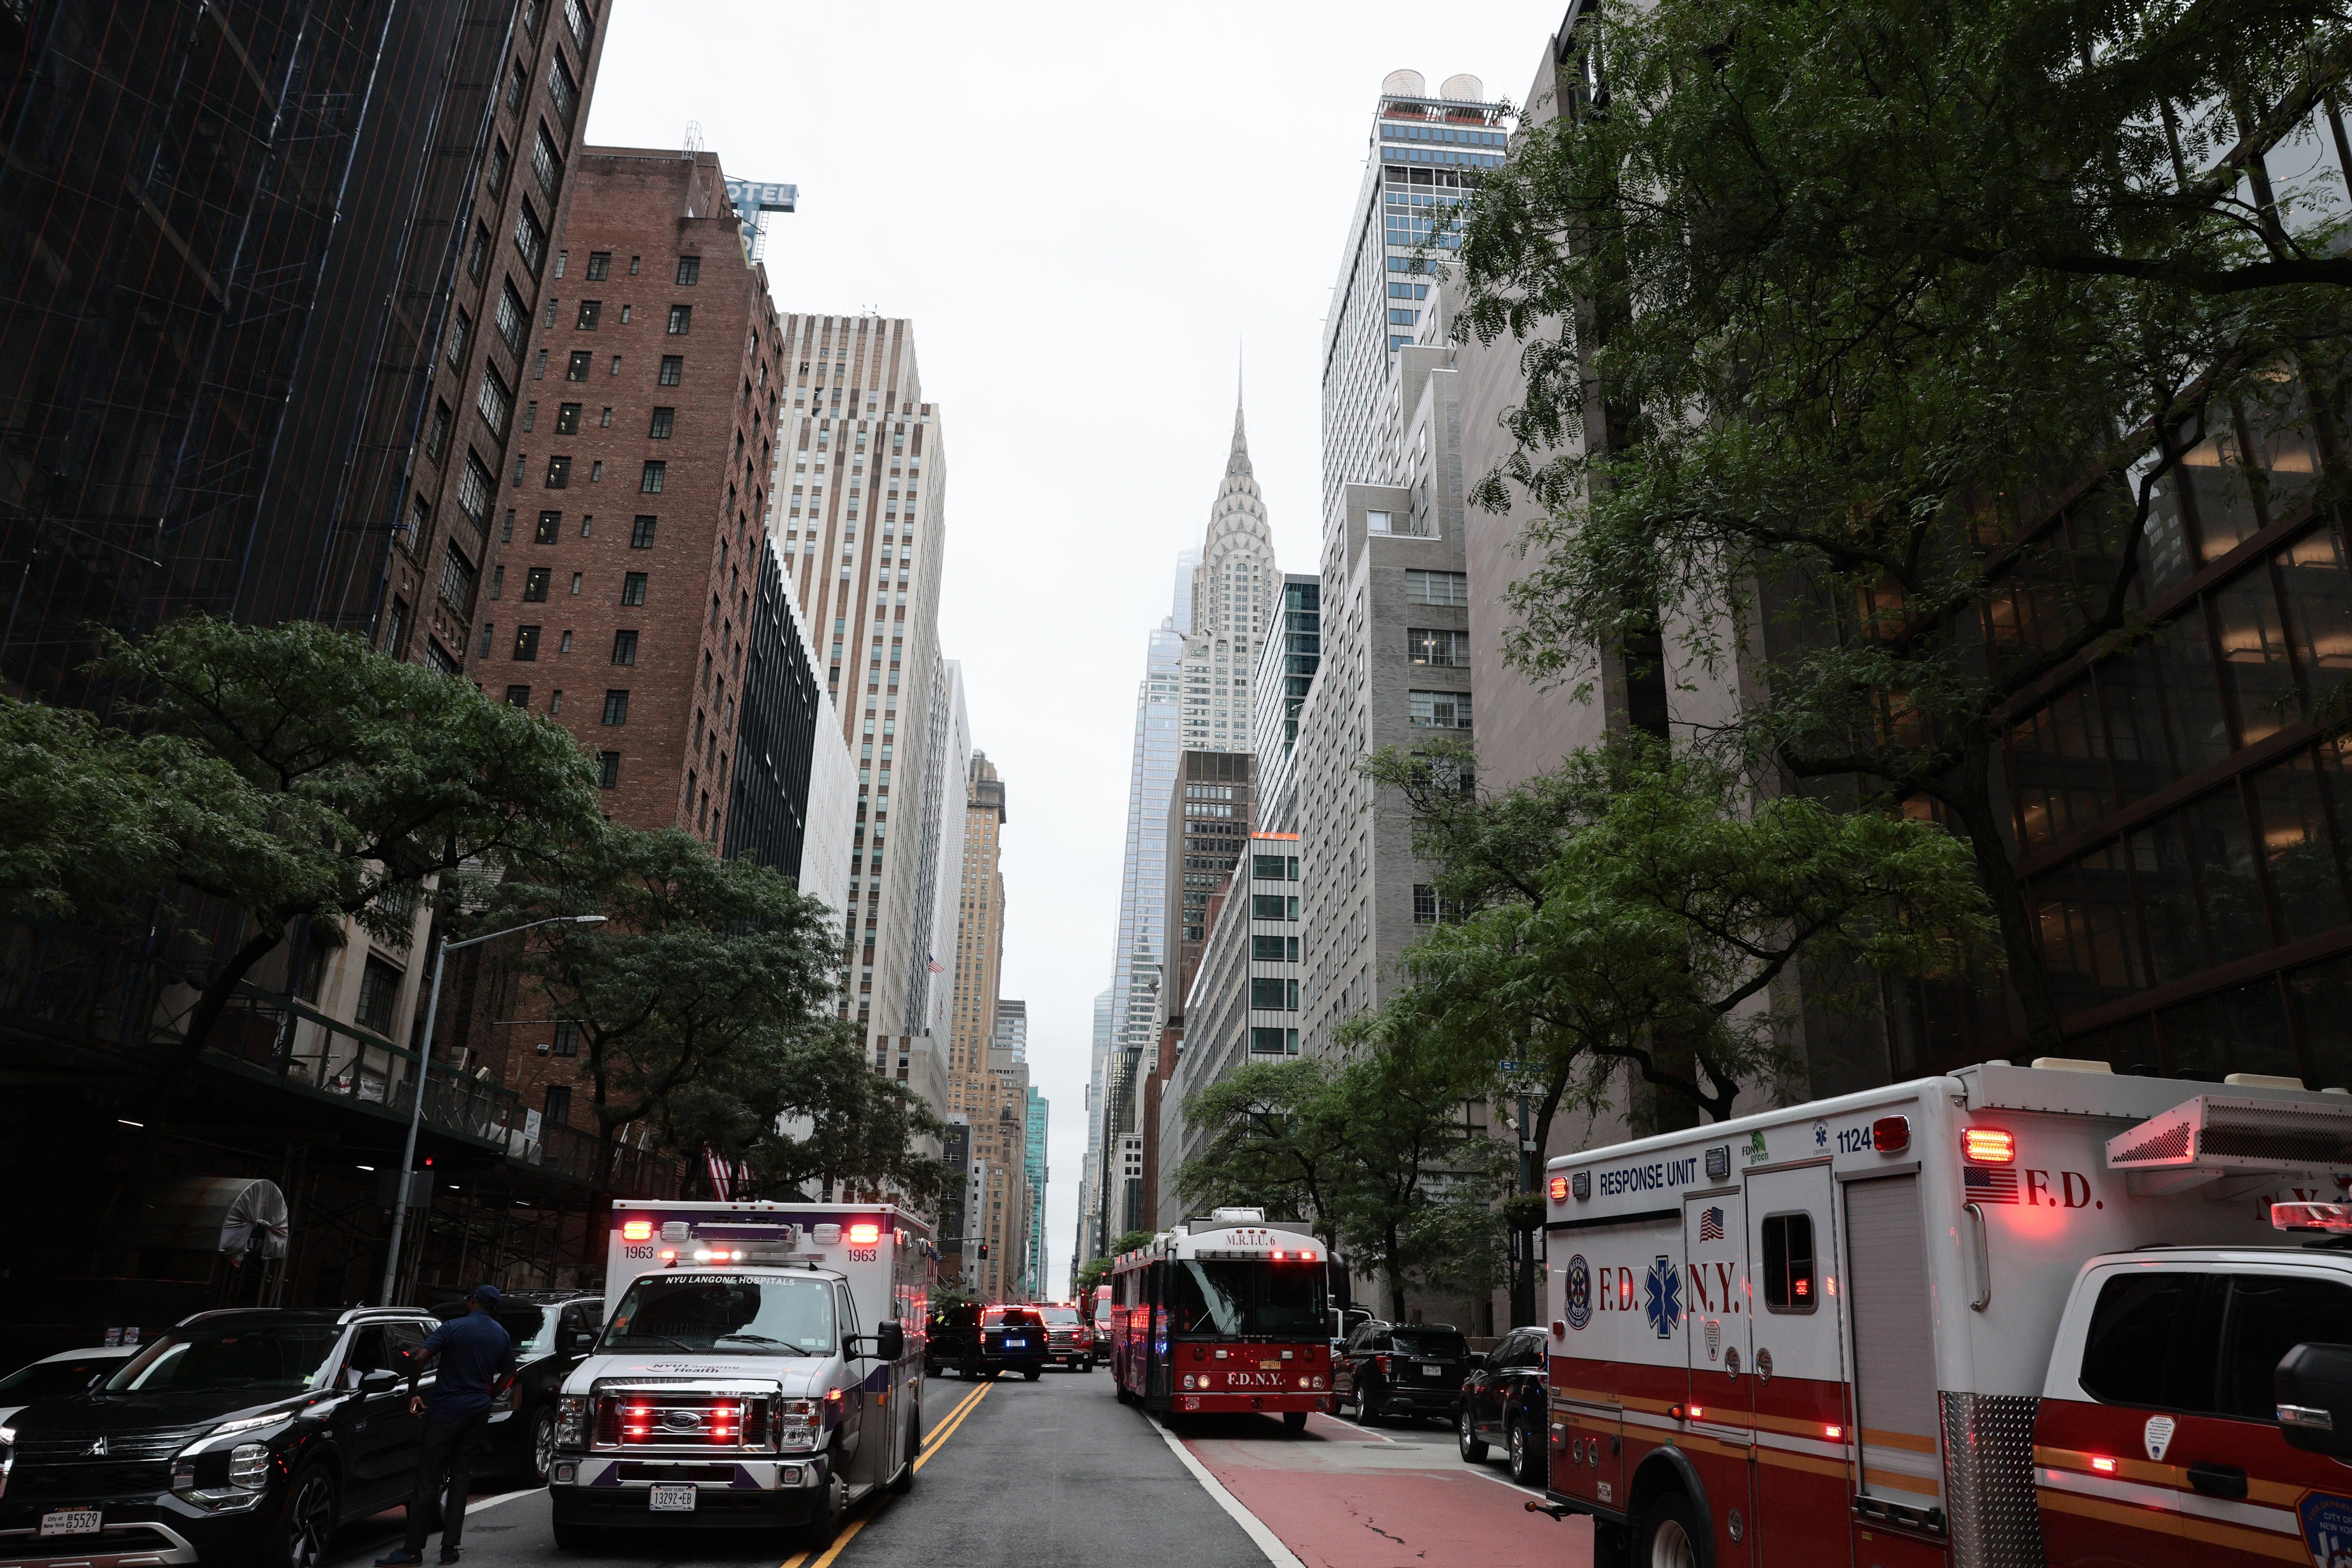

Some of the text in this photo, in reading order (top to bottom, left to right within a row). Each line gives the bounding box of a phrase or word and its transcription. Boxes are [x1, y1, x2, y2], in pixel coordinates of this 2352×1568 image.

[727, 183, 792, 202] OTEL
[1837, 1127, 1872, 1154] 1124
[1742, 1144, 1759, 1156] FDNY
[1750, 1153, 1769, 1164] green
[1600, 1158, 1697, 1196] RESPONSE UNIT
[2024, 1169, 2103, 1210] F.D.
[1226, 1235, 1275, 1246] M.R.T.U. 6
[624, 1246, 654, 1258] 1963
[847, 1250, 876, 1262] 1963
[1570, 1259, 1586, 1273] RESCUE
[688, 1276, 737, 1284] LANGONE
[739, 1277, 795, 1286] HOSPITALS
[1572, 1304, 1585, 1317] MEDIC
[1228, 1373, 1282, 1385] F.D.N.Y.
[672, 1417, 691, 1425] Ford
[2324, 1512, 2341, 1522] CITY
[2320, 1521, 2337, 1531] NEW
